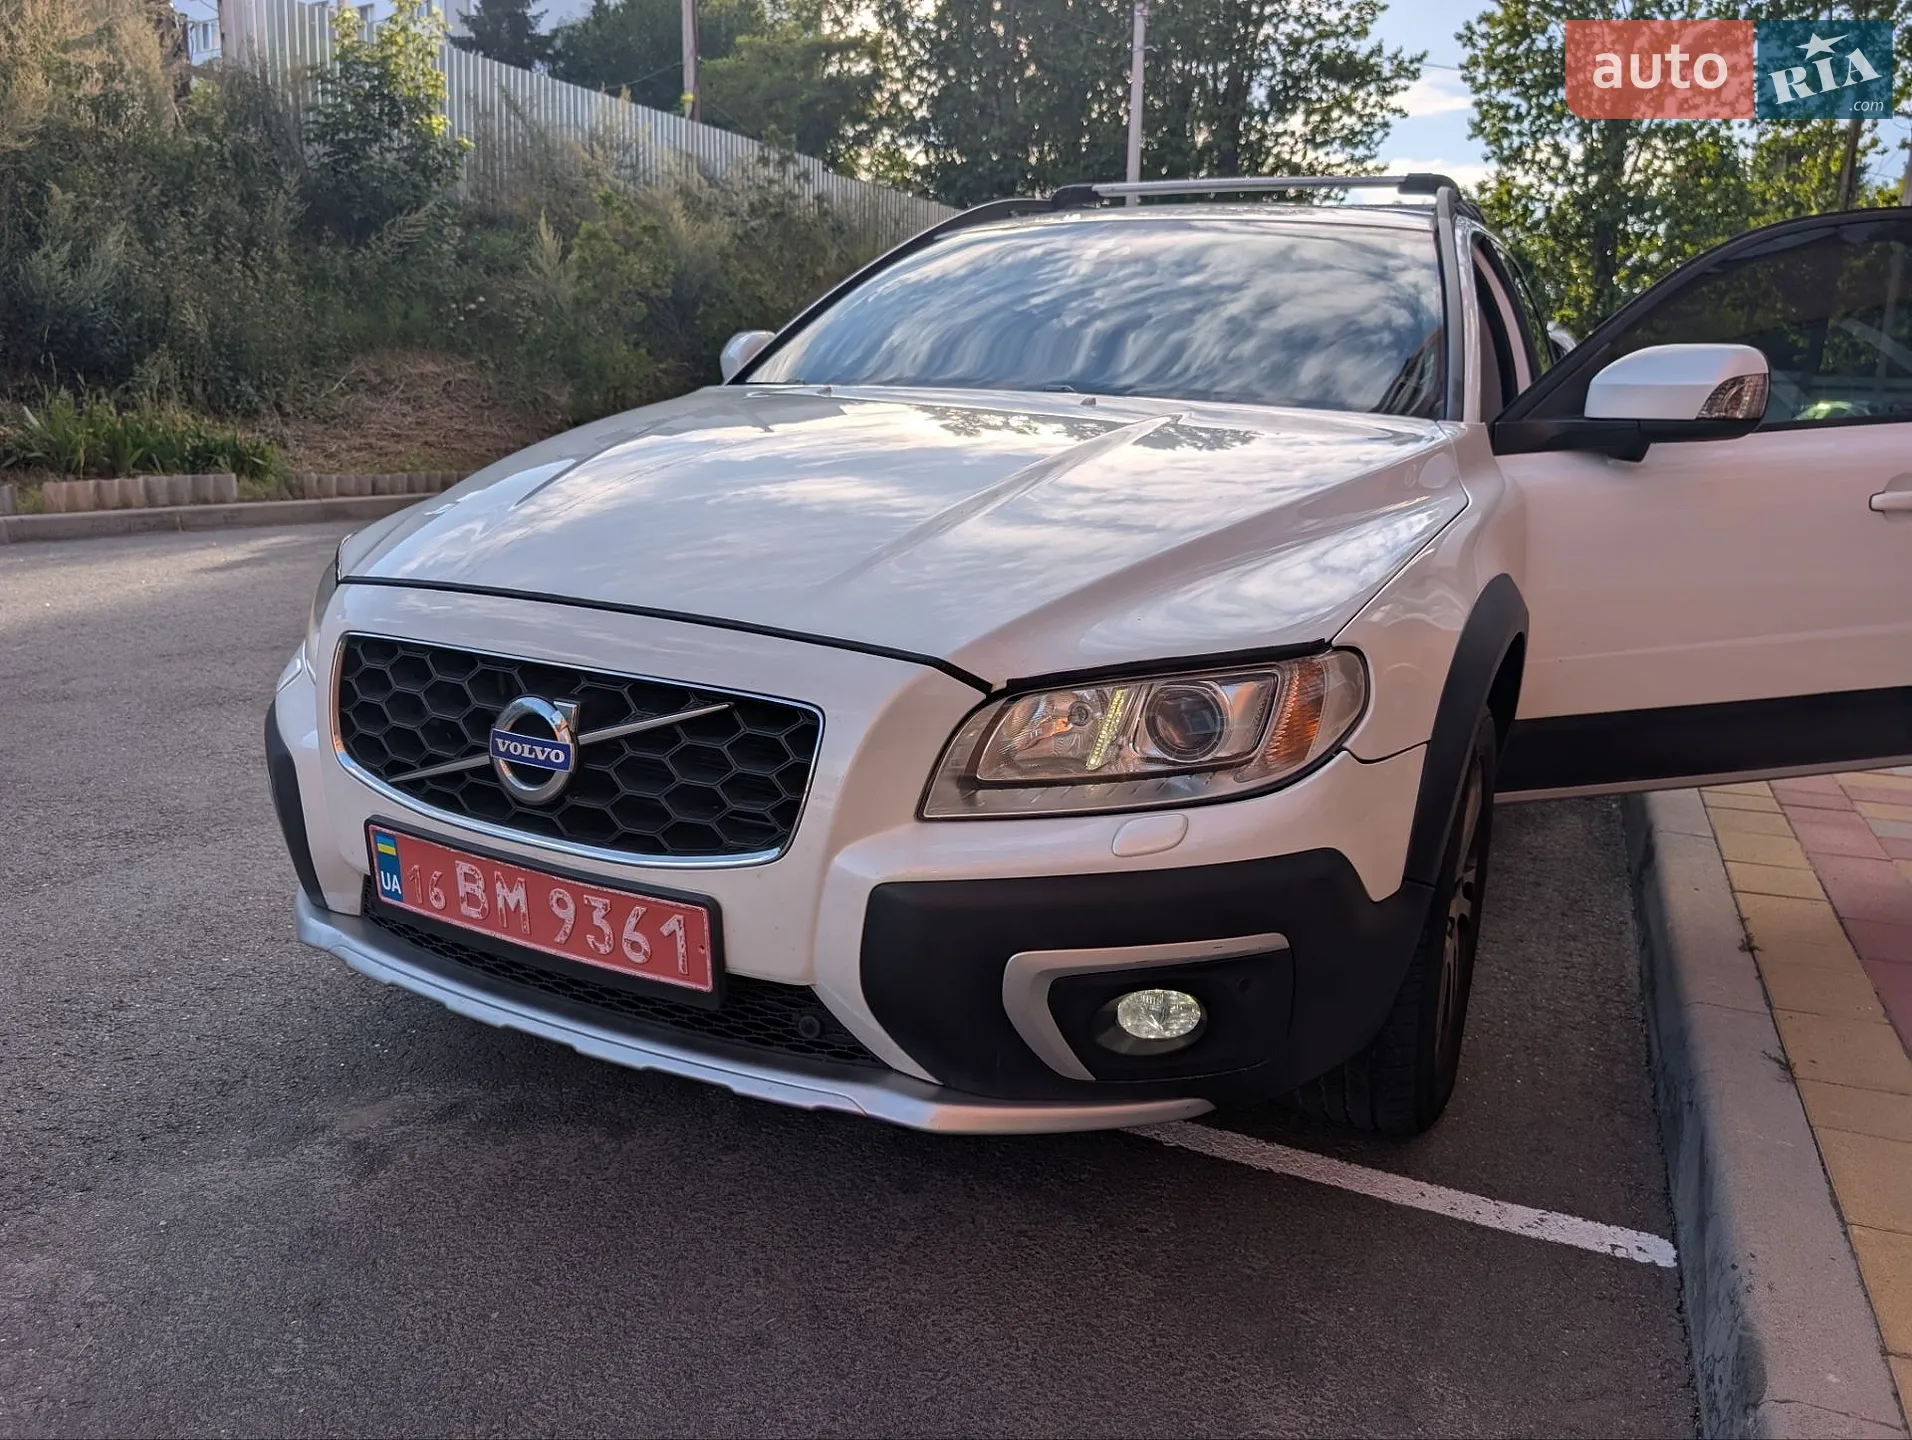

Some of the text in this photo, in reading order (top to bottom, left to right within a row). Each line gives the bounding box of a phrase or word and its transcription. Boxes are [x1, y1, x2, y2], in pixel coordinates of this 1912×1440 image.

[494, 737, 566, 764] VOLVO
[379, 870, 402, 895] UA
[548, 888, 690, 975] 9361
